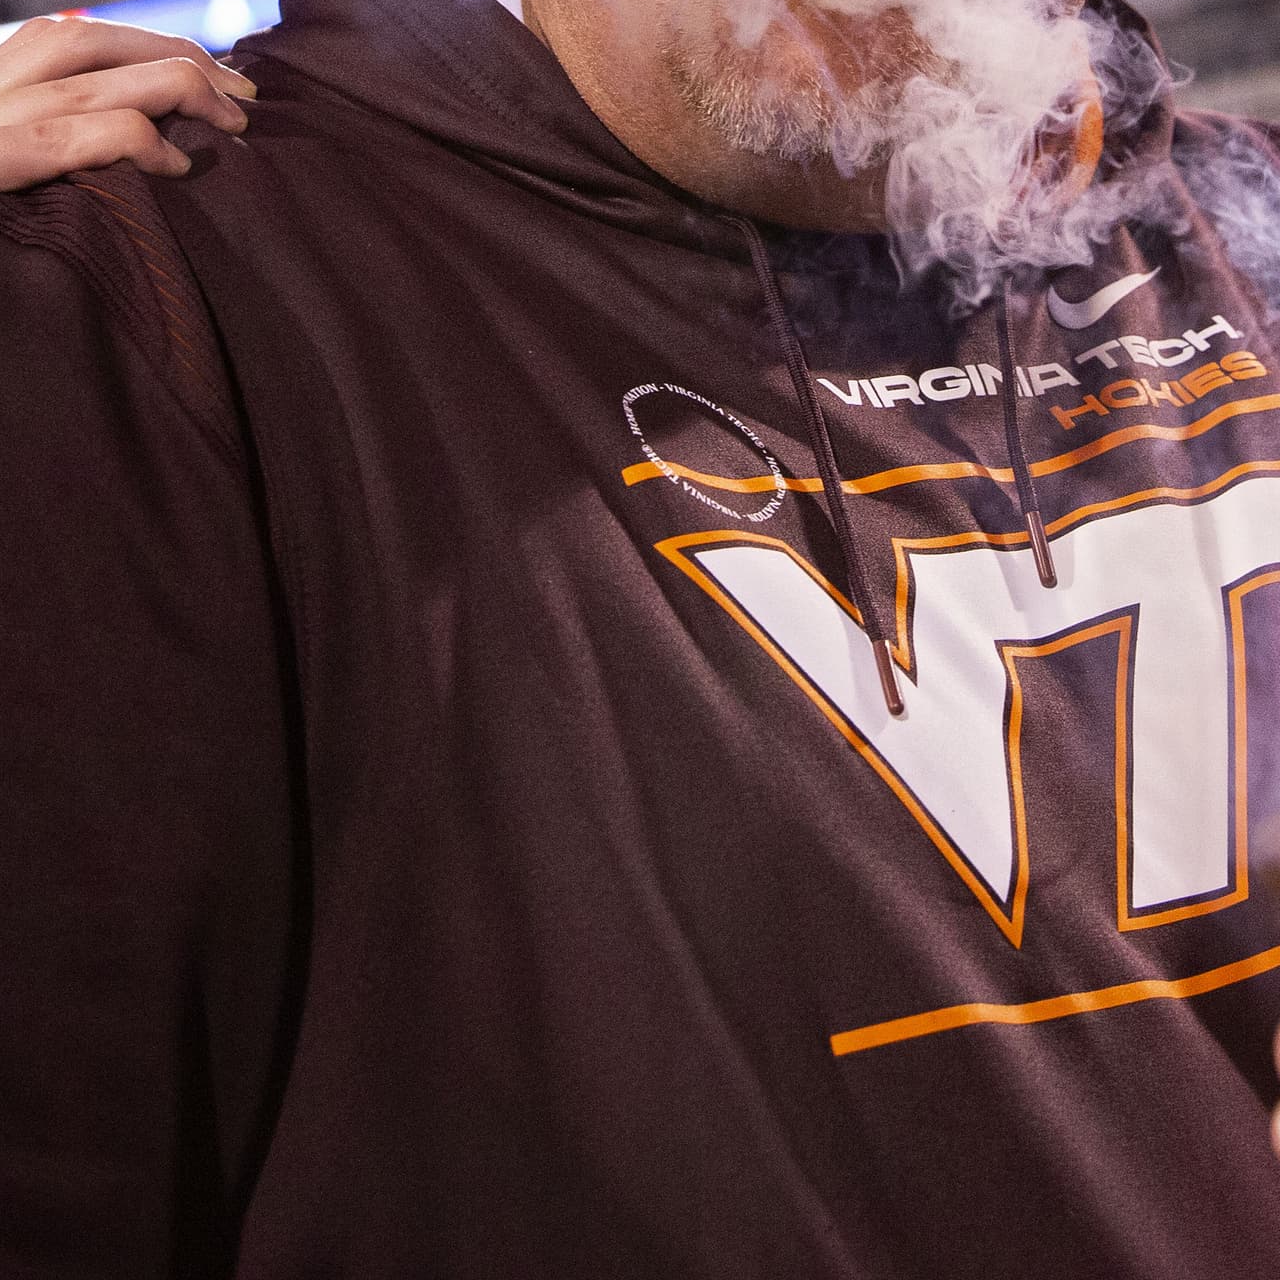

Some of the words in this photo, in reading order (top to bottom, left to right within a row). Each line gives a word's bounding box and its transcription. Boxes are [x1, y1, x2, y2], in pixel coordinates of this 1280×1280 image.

[817, 361, 1081, 408] VIRGINIA
[1073, 314, 1241, 371] TECH
[623, 382, 660, 404] NATION
[663, 382, 725, 416] VIRGINIA
[1049, 350, 1268, 431] HOKIES
[682, 481, 742, 520] VIRGINIA
[747, 498, 782, 522] NATION
